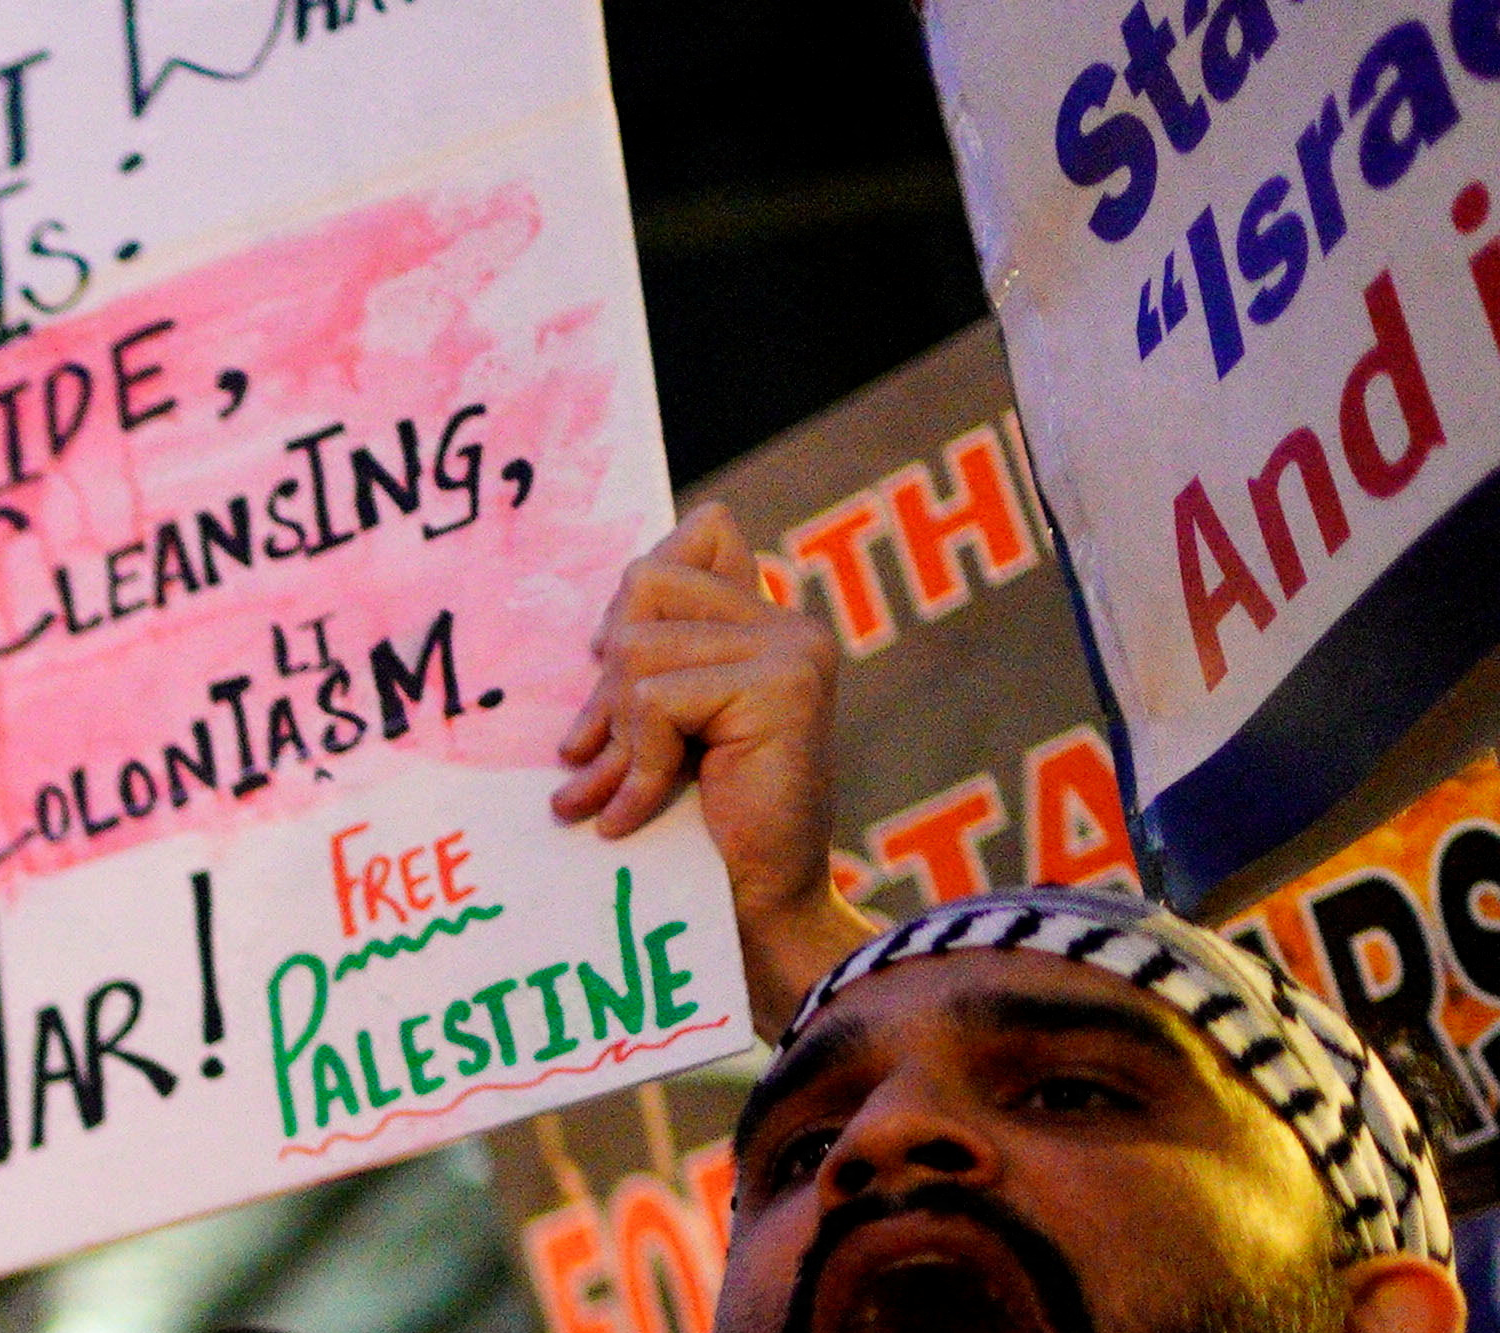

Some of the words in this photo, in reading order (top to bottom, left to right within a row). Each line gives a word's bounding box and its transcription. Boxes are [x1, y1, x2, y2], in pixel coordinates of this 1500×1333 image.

[1173, 268, 1447, 695] And
[267, 866, 699, 1137] PALESTINE
[329, 821, 477, 938] FREE
